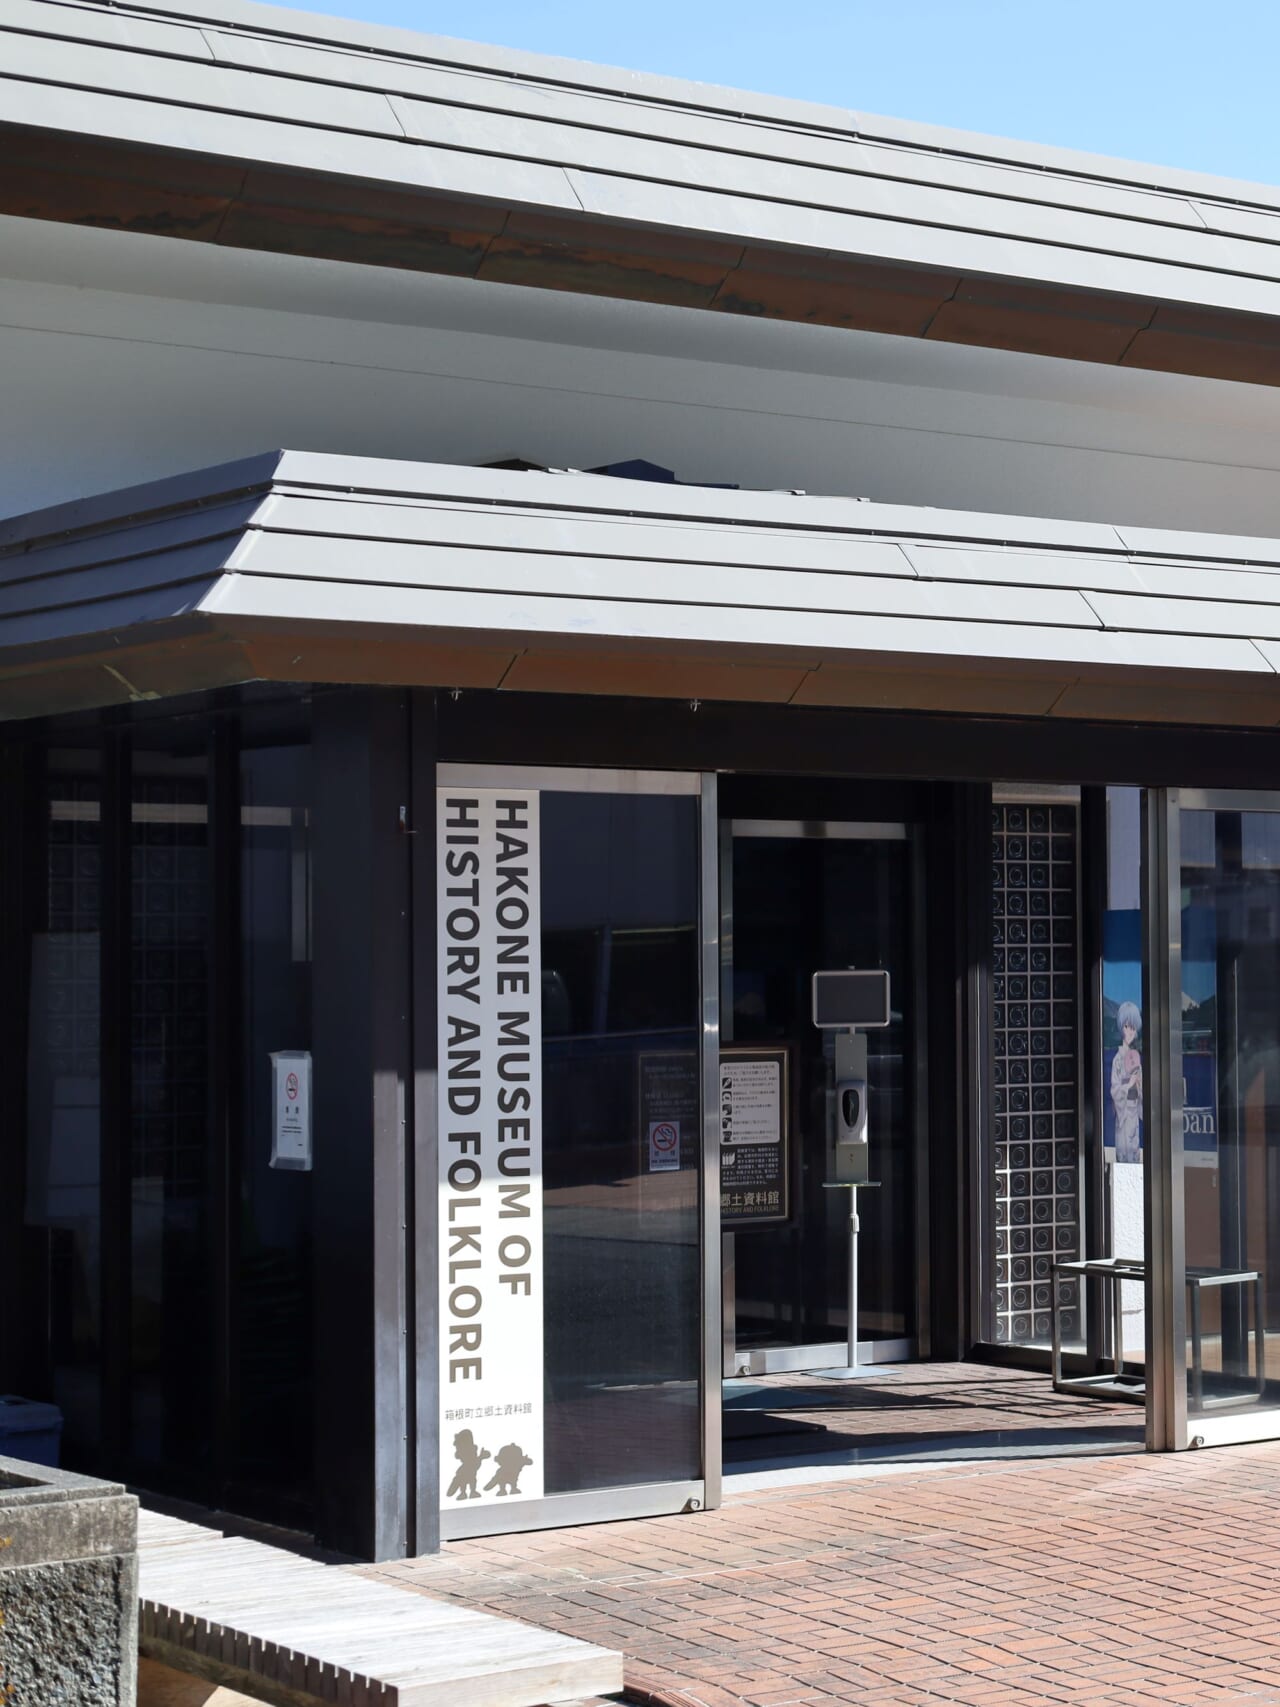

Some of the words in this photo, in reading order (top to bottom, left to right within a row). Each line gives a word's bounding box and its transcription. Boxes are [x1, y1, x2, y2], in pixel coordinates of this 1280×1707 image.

[445, 798, 481, 1005] HISTORY
[495, 799, 531, 996] HAKONE
[447, 1015, 481, 1116] AND
[496, 1011, 532, 1219] MUSEUM
[447, 1131, 482, 1384] FOLKLORE
[498, 1234, 532, 1297] OF
[444, 1402, 532, 1421] 箱根町立郷土資料館
